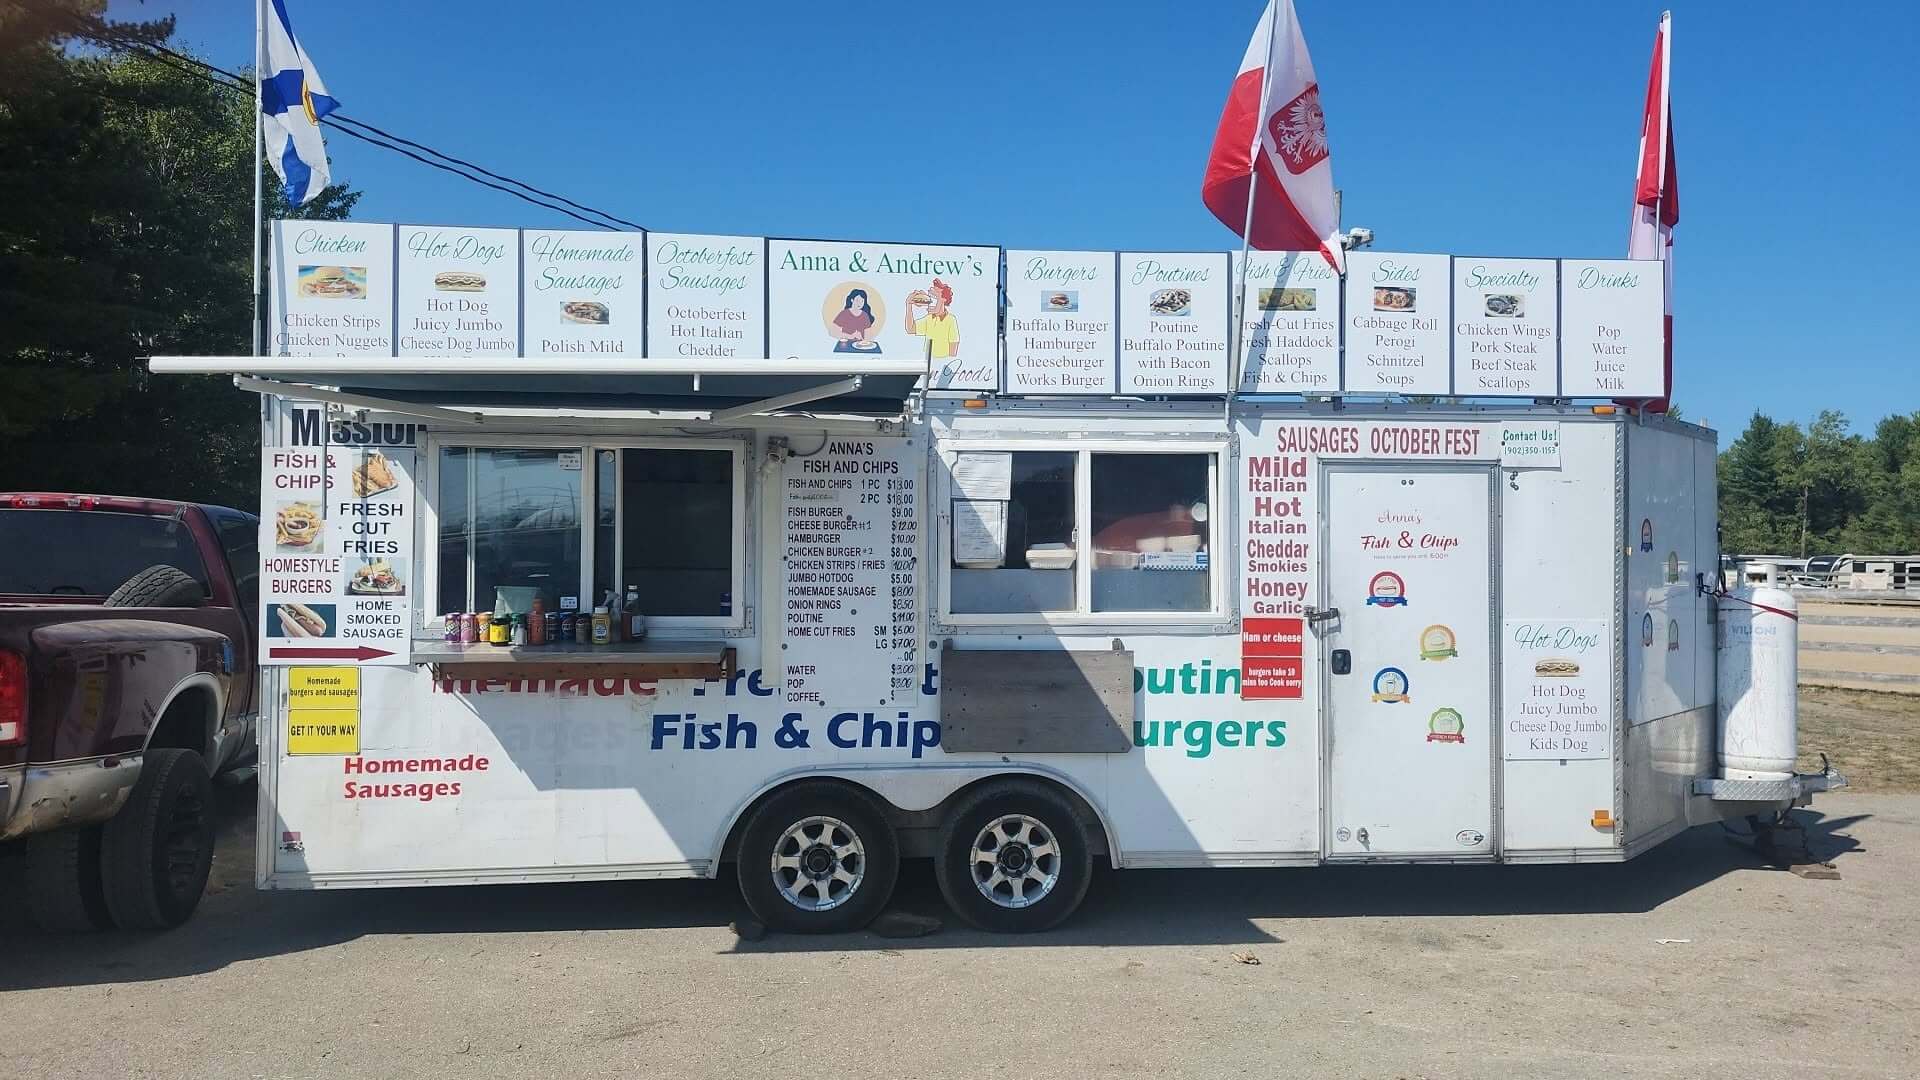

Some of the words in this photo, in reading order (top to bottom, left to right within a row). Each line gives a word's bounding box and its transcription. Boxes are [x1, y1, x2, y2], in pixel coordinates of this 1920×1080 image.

[295, 229, 366, 254] Chicken
[408, 231, 452, 259] Hot
[453, 235, 505, 265] Dogs
[531, 234, 634, 263] Homemade
[656, 240, 758, 271] Octoberfest
[780, 249, 840, 273] Anna
[848, 252, 869, 274] &
[1024, 256, 1098, 286] Burgers
[1132, 260, 1210, 285] Poutines
[1274, 257, 1289, 280] &
[1293, 257, 1333, 281] Fries
[1371, 260, 1421, 283] Sides
[534, 267, 623, 295] Sausages
[660, 266, 746, 296] Sausages
[1465, 265, 1540, 292] Specialty
[1577, 266, 1640, 290] Drinks
[427, 299, 455, 312] Hot
[459, 299, 489, 316] Dog
[667, 305, 747, 321] Octoberfest
[285, 314, 338, 327] Chicken
[343, 315, 381, 331] Strips
[1012, 319, 1060, 332] Buffalo
[1065, 320, 1109, 334] Burger
[1150, 320, 1198, 333] Poutine
[1243, 318, 1299, 330] resh-Cut
[1304, 318, 1334, 330] Fries
[1353, 316, 1408, 333] Cabbage
[1412, 318, 1438, 331] Roll
[671, 324, 697, 337] Hot
[700, 325, 743, 339] Italian
[1457, 324, 1508, 337] Chicken
[1512, 324, 1551, 339] Wings
[1598, 325, 1621, 339] Pop
[276, 333, 330, 346] Chicken
[335, 334, 388, 350] Nuggets
[542, 340, 585, 353] Polish
[590, 340, 624, 353] Mild
[1025, 337, 1096, 353] Hamburger
[1277, 335, 1333, 348] Haddock
[1375, 335, 1415, 351] Perogi
[1471, 341, 1499, 354] Pork
[1504, 342, 1537, 354] Steak
[678, 343, 736, 357] Chedder
[1592, 343, 1627, 355] Water
[1016, 355, 1104, 371] Cheeseburger
[1138, 356, 1165, 369] with
[1170, 357, 1210, 369] Bacon
[1259, 354, 1312, 368] Scallops
[1367, 354, 1424, 368] Schnitzel
[1594, 360, 1625, 373] Juice
[1016, 373, 1056, 386] Works
[1061, 374, 1105, 389] Burger
[1134, 374, 1173, 387] Onion
[1177, 375, 1215, 389] Rings
[1244, 371, 1270, 384] Fish
[1275, 371, 1286, 384] &
[1291, 371, 1328, 387] Chips
[1377, 372, 1415, 387] Soups
[1596, 377, 1625, 390] Milk
[1277, 426, 1359, 454] SAUSAGES
[1371, 428, 1441, 455] OCTOBER
[1444, 429, 1480, 455] FEST
[1503, 429, 1537, 441] Contact
[1541, 429, 1557, 441] Us!
[829, 442, 873, 455] ANNA'S
[274, 454, 317, 468] FISH
[326, 455, 337, 468] &
[803, 461, 830, 473] FISH
[834, 461, 859, 473] AND
[863, 461, 898, 474] CHIPS
[1249, 456, 1307, 478] Mild
[276, 475, 334, 489] CHIPS
[868, 480, 880, 489] PC
[1249, 478, 1307, 492] Italian
[868, 494, 880, 503] PC
[340, 503, 403, 516] FRESH
[808, 507, 843, 516] BURGER
[1254, 497, 1302, 517] Hot
[352, 523, 391, 535] CUT
[788, 521, 821, 530] CHEESE
[823, 521, 857, 530] BURGER
[1249, 520, 1307, 535] Italian
[788, 534, 841, 543] HAMBURGER
[1360, 535, 1392, 550] Fish
[1397, 530, 1414, 549] &
[1420, 533, 1459, 551] Chips
[343, 541, 398, 553] FRIES
[788, 547, 824, 556] CHICKEN
[827, 547, 861, 556] BURGER
[891, 547, 912, 557] $8.00
[1247, 539, 1309, 559] Cheddar
[265, 559, 339, 573] HOMESTYLE
[862, 561, 885, 569] FRIES
[1248, 560, 1307, 573] Smokies
[788, 573, 816, 582] JUMBO
[819, 573, 853, 582] HOTDOG
[891, 574, 912, 583] $5.00
[272, 580, 332, 593] BURGERS
[788, 586, 835, 596] HOMEMADE
[838, 586, 877, 596] SAUSAGE
[1247, 578, 1308, 601] Honey
[356, 601, 393, 611] HOME
[788, 600, 813, 609] ONION
[816, 600, 841, 609] RINGS
[1253, 601, 1303, 614] Garlic
[347, 615, 401, 625] SMOKED
[788, 614, 823, 622] POUTINE
[343, 629, 404, 639] SAUSAGE
[788, 627, 811, 636] HOME
[814, 627, 830, 636] CUT
[832, 627, 855, 636] FRIES
[874, 626, 887, 635] SM
[1243, 632, 1261, 643] Ham
[1262, 634, 1271, 642] or
[1272, 632, 1301, 643] cheese
[876, 639, 888, 648] LG
[1514, 624, 1552, 649] Hot
[1553, 627, 1598, 654] Dogs
[787, 665, 816, 675] WATER
[307, 677, 341, 685] Homemade
[787, 679, 804, 688] POP
[787, 692, 820, 702] COFFEE
[1533, 685, 1555, 697] Hot
[1560, 685, 1586, 699] Dog
[1520, 703, 1553, 718] Juicy
[1556, 703, 1597, 714] Jumbo
[291, 726, 305, 736] GET
[307, 726, 314, 736] IT
[316, 726, 337, 736] YOUR
[340, 725, 356, 736] WAY
[651, 711, 757, 750] Fish
[774, 713, 811, 749] &
[827, 712, 941, 758] Chip
[1510, 720, 1546, 732] Cheese
[1550, 721, 1571, 735] Dog
[1573, 720, 1607, 732] Jumbo
[1133, 720, 1287, 758] urgers
[1530, 738, 1559, 750] Kids
[1563, 738, 1588, 752] Dog
[344, 754, 489, 774] Homemade
[344, 781, 462, 802] Sausages
